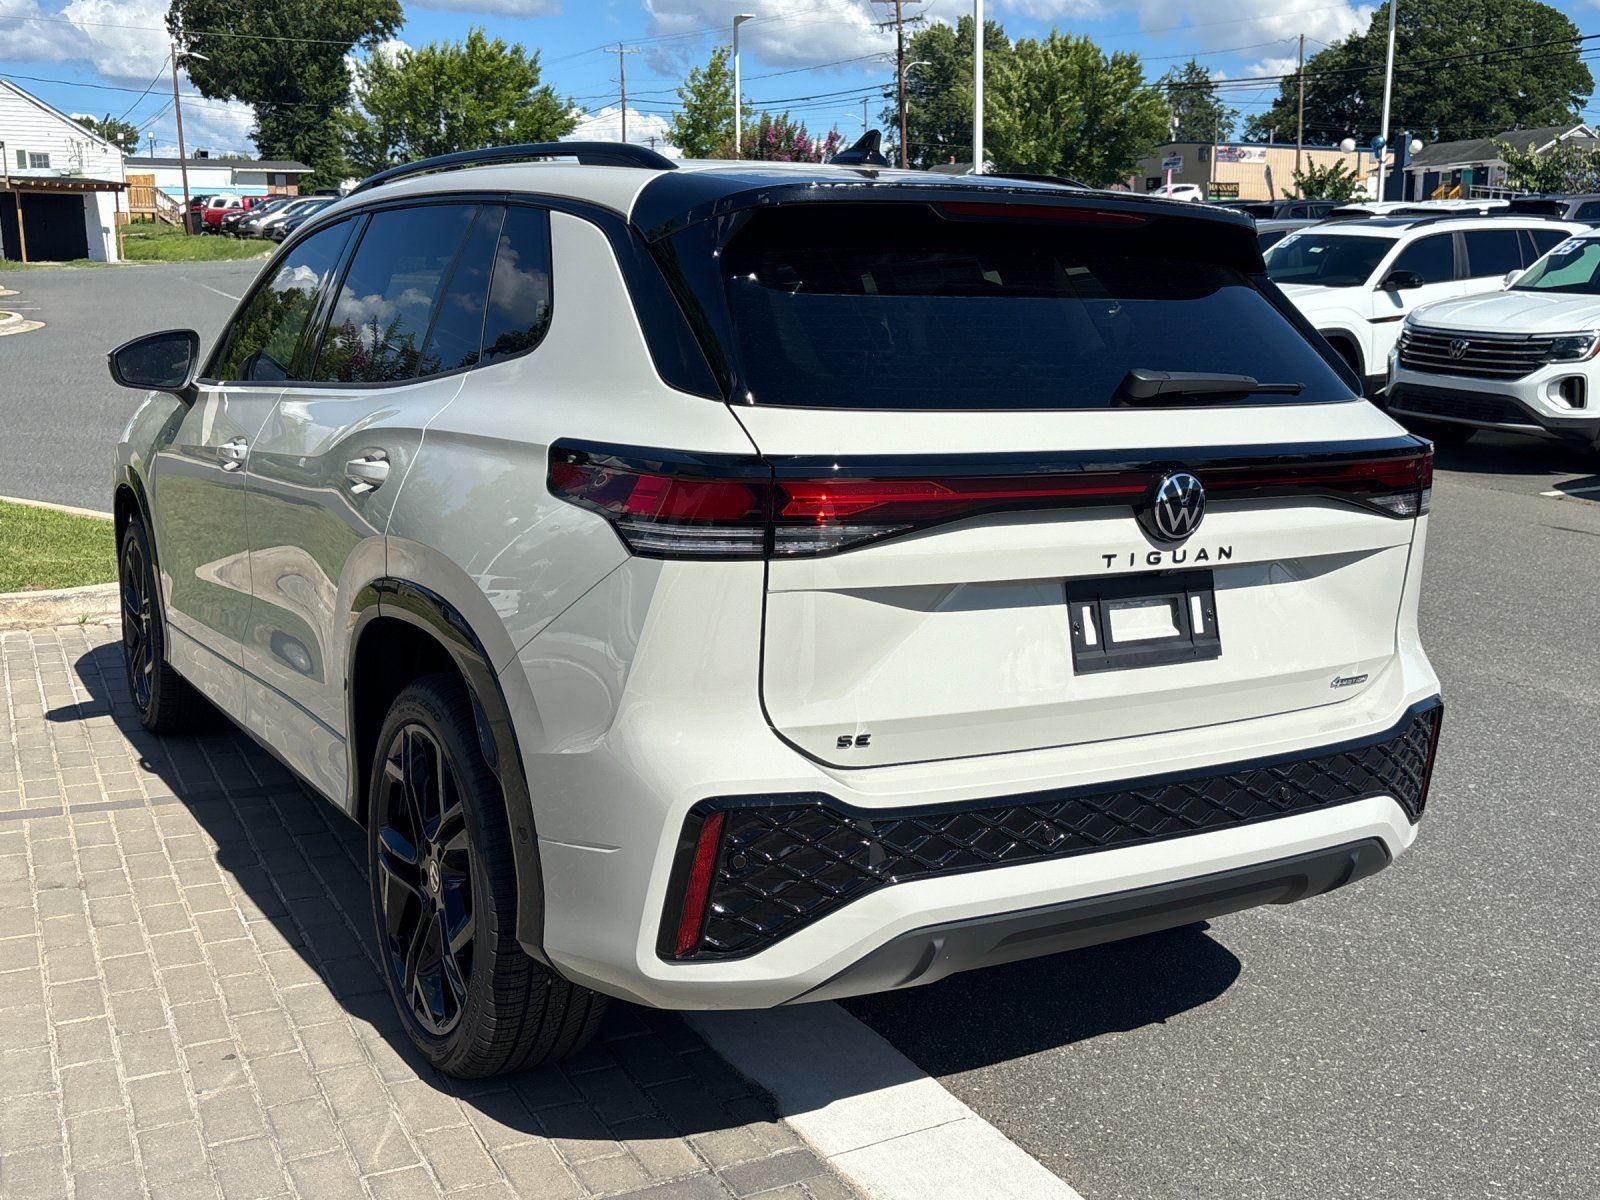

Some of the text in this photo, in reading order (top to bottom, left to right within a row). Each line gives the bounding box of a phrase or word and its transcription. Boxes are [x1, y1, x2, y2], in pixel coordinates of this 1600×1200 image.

[1155, 473, 1205, 539] VW
[1102, 546, 1232, 568] TIGUAN
[836, 734, 871, 749] SE
